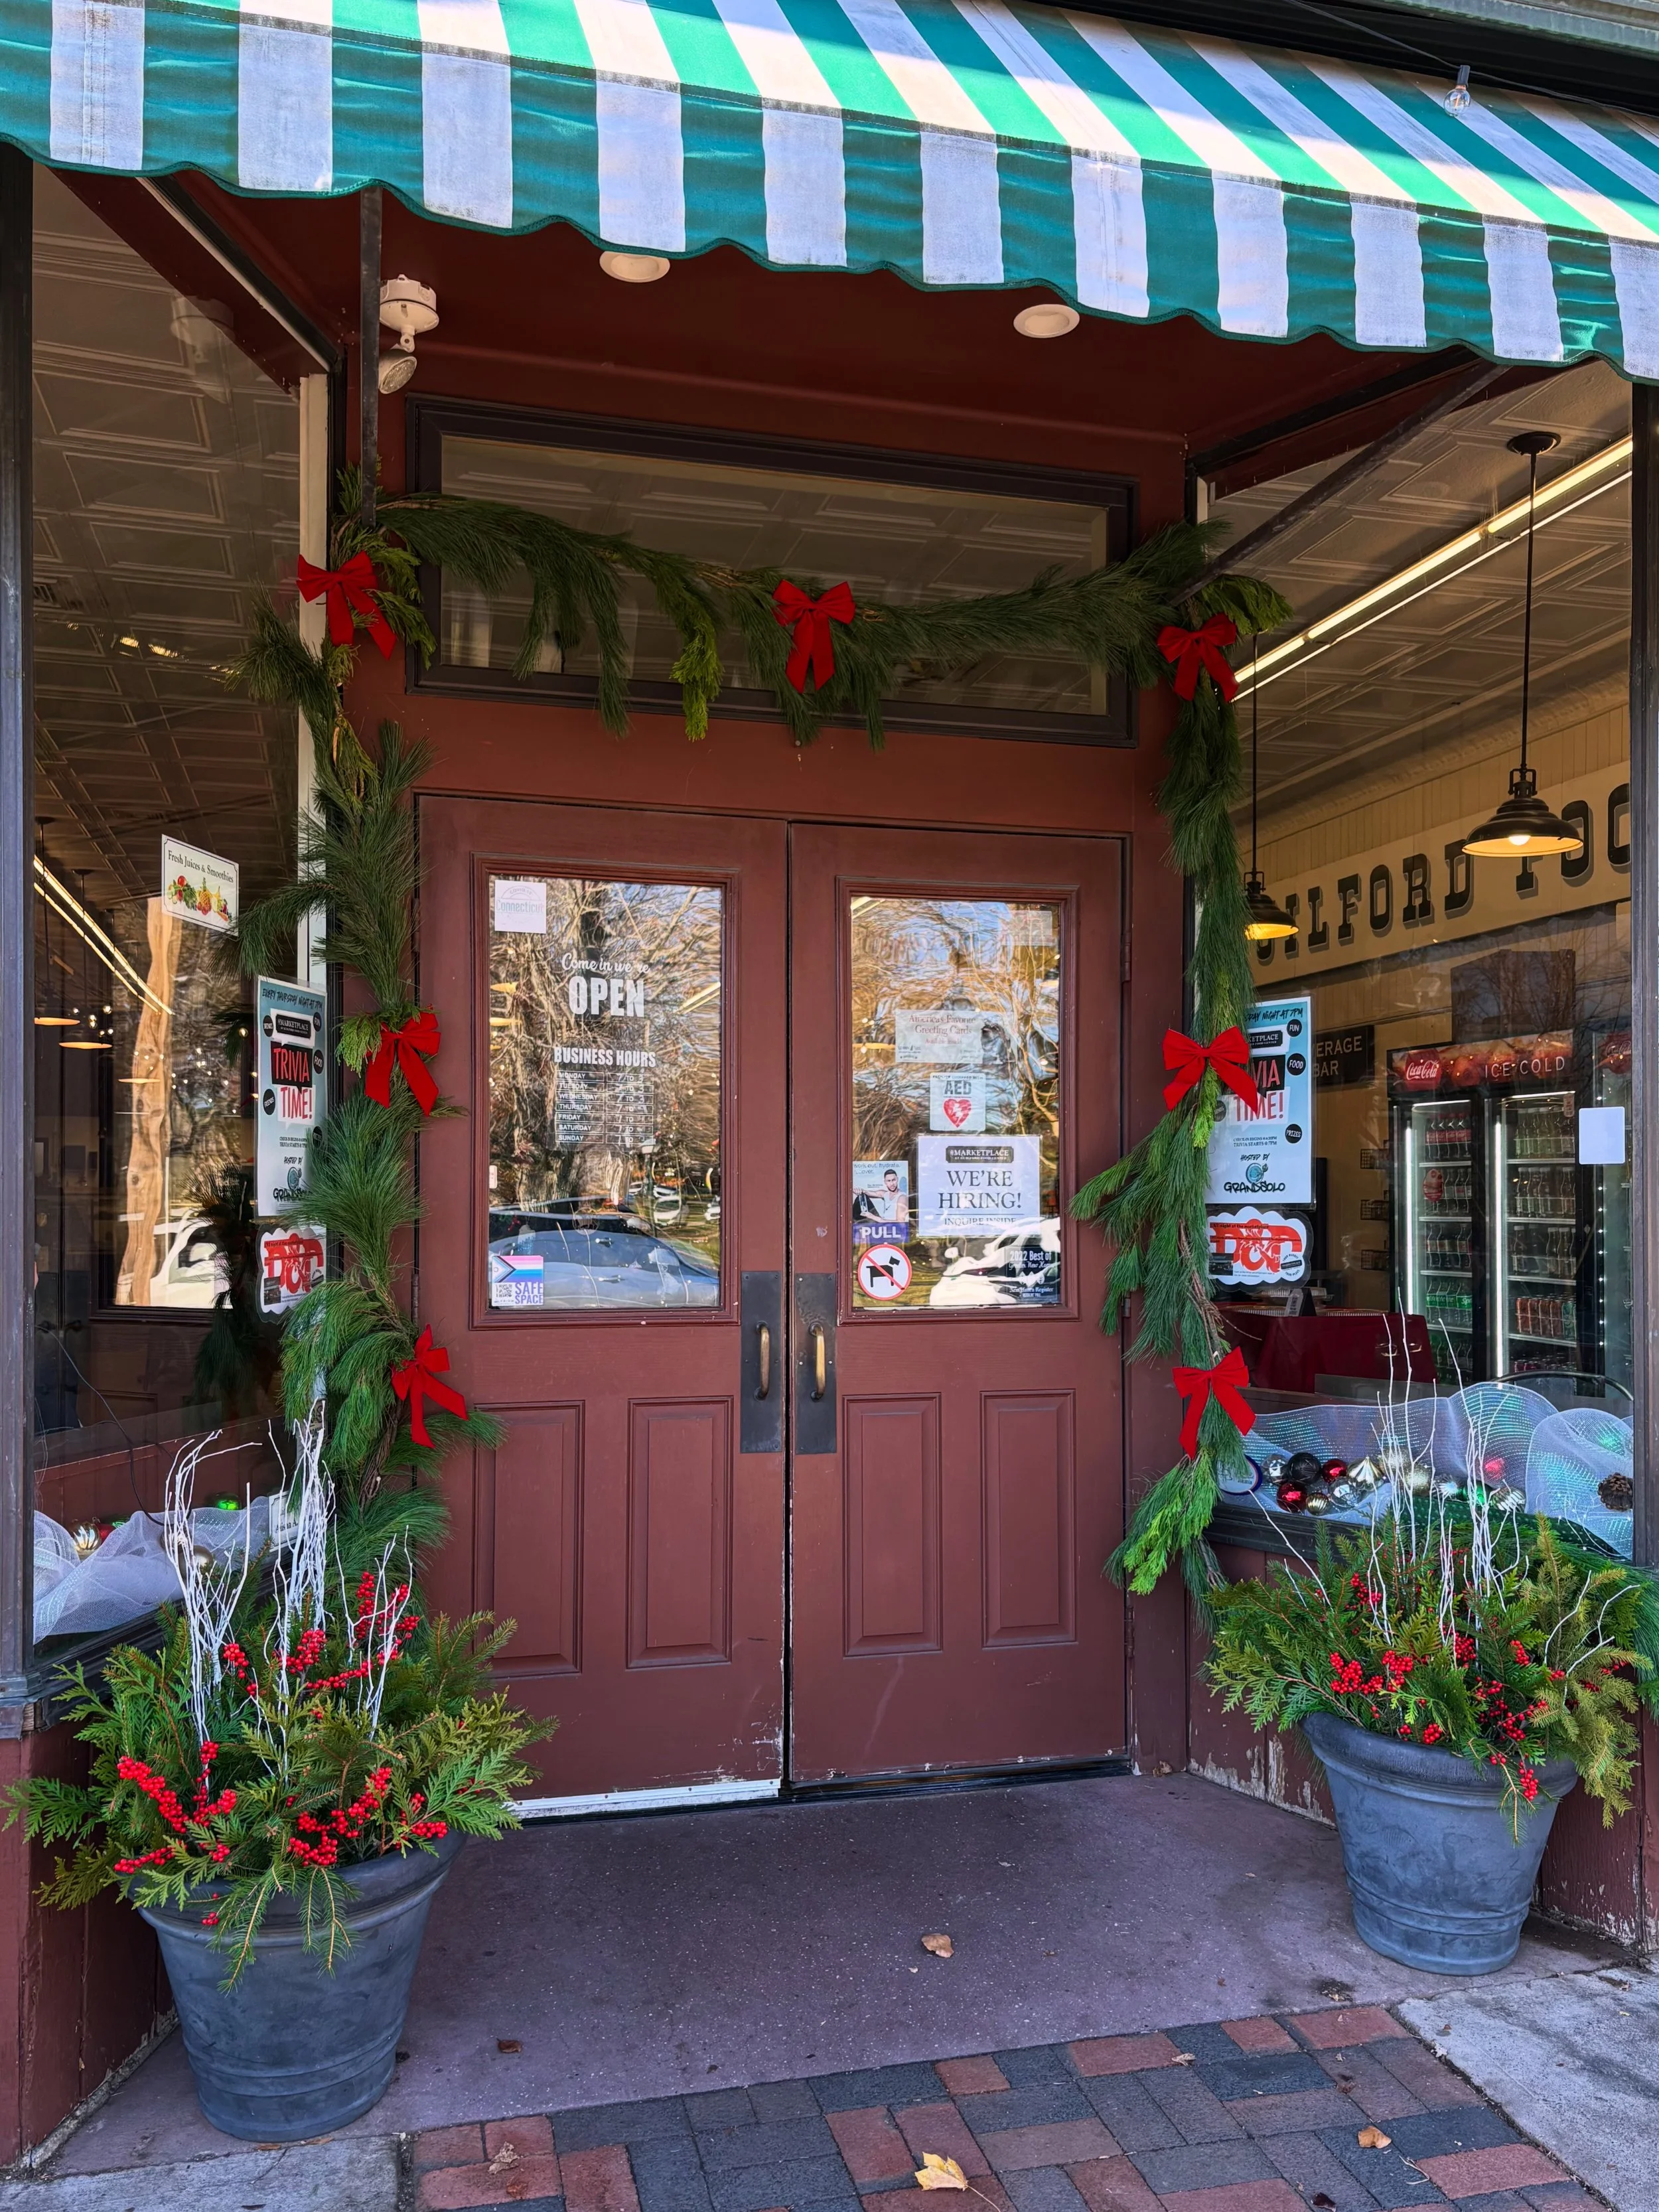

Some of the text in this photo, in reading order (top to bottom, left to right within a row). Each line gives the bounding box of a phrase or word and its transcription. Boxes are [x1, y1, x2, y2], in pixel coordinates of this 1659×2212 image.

[168, 850, 183, 865] Fresh
[184, 856, 200, 870] Juices
[207, 865, 234, 883] Smoothies
[496, 899, 544, 913] Connecticut
[1256, 839, 1474, 960] ILFORD
[561, 952, 597, 970] Come
[599, 957, 613, 971] in
[263, 988, 276, 1000] EVERY
[276, 991, 298, 1006] THURSDAY
[299, 995, 309, 1007] NIGHT
[569, 976, 644, 1017] OPEN
[1262, 1010, 1279, 1021] NIGHT
[1280, 1009, 1289, 1019] AT
[1289, 1008, 1303, 1018] 7PM
[915, 1025, 972, 1037] Greeting Cards
[1317, 1036, 1362, 1057] ERAGE
[553, 1047, 656, 1067] BUSINESS HOURS
[1289, 1059, 1304, 1069] FOOD
[273, 1048, 310, 1083] TRIVIA
[1252, 1059, 1281, 1088] VIA
[1313, 1061, 1338, 1077] BAR
[1485, 1057, 1565, 1078] ICE COLD
[944, 1080, 972, 1095] AED
[264, 1096, 274, 1108] FRIENDS
[280, 1086, 313, 1120] TIME!
[1233, 1092, 1283, 1122] TIME!
[1286, 1129, 1301, 1138] PRIZES
[1262, 1153, 1270, 1161] BY
[946, 1170, 1013, 1187] WE'RE
[1224, 1181, 1286, 1193] GRANDSOLO
[938, 1192, 1022, 1209] HIRING!
[944, 1217, 984, 1226] INQUIRE
[861, 1226, 901, 1238] PULL
[1010, 1250, 1052, 1261] 2022 Best of
[515, 1282, 543, 1295] SAFE
[515, 1294, 543, 1305] SPACE
